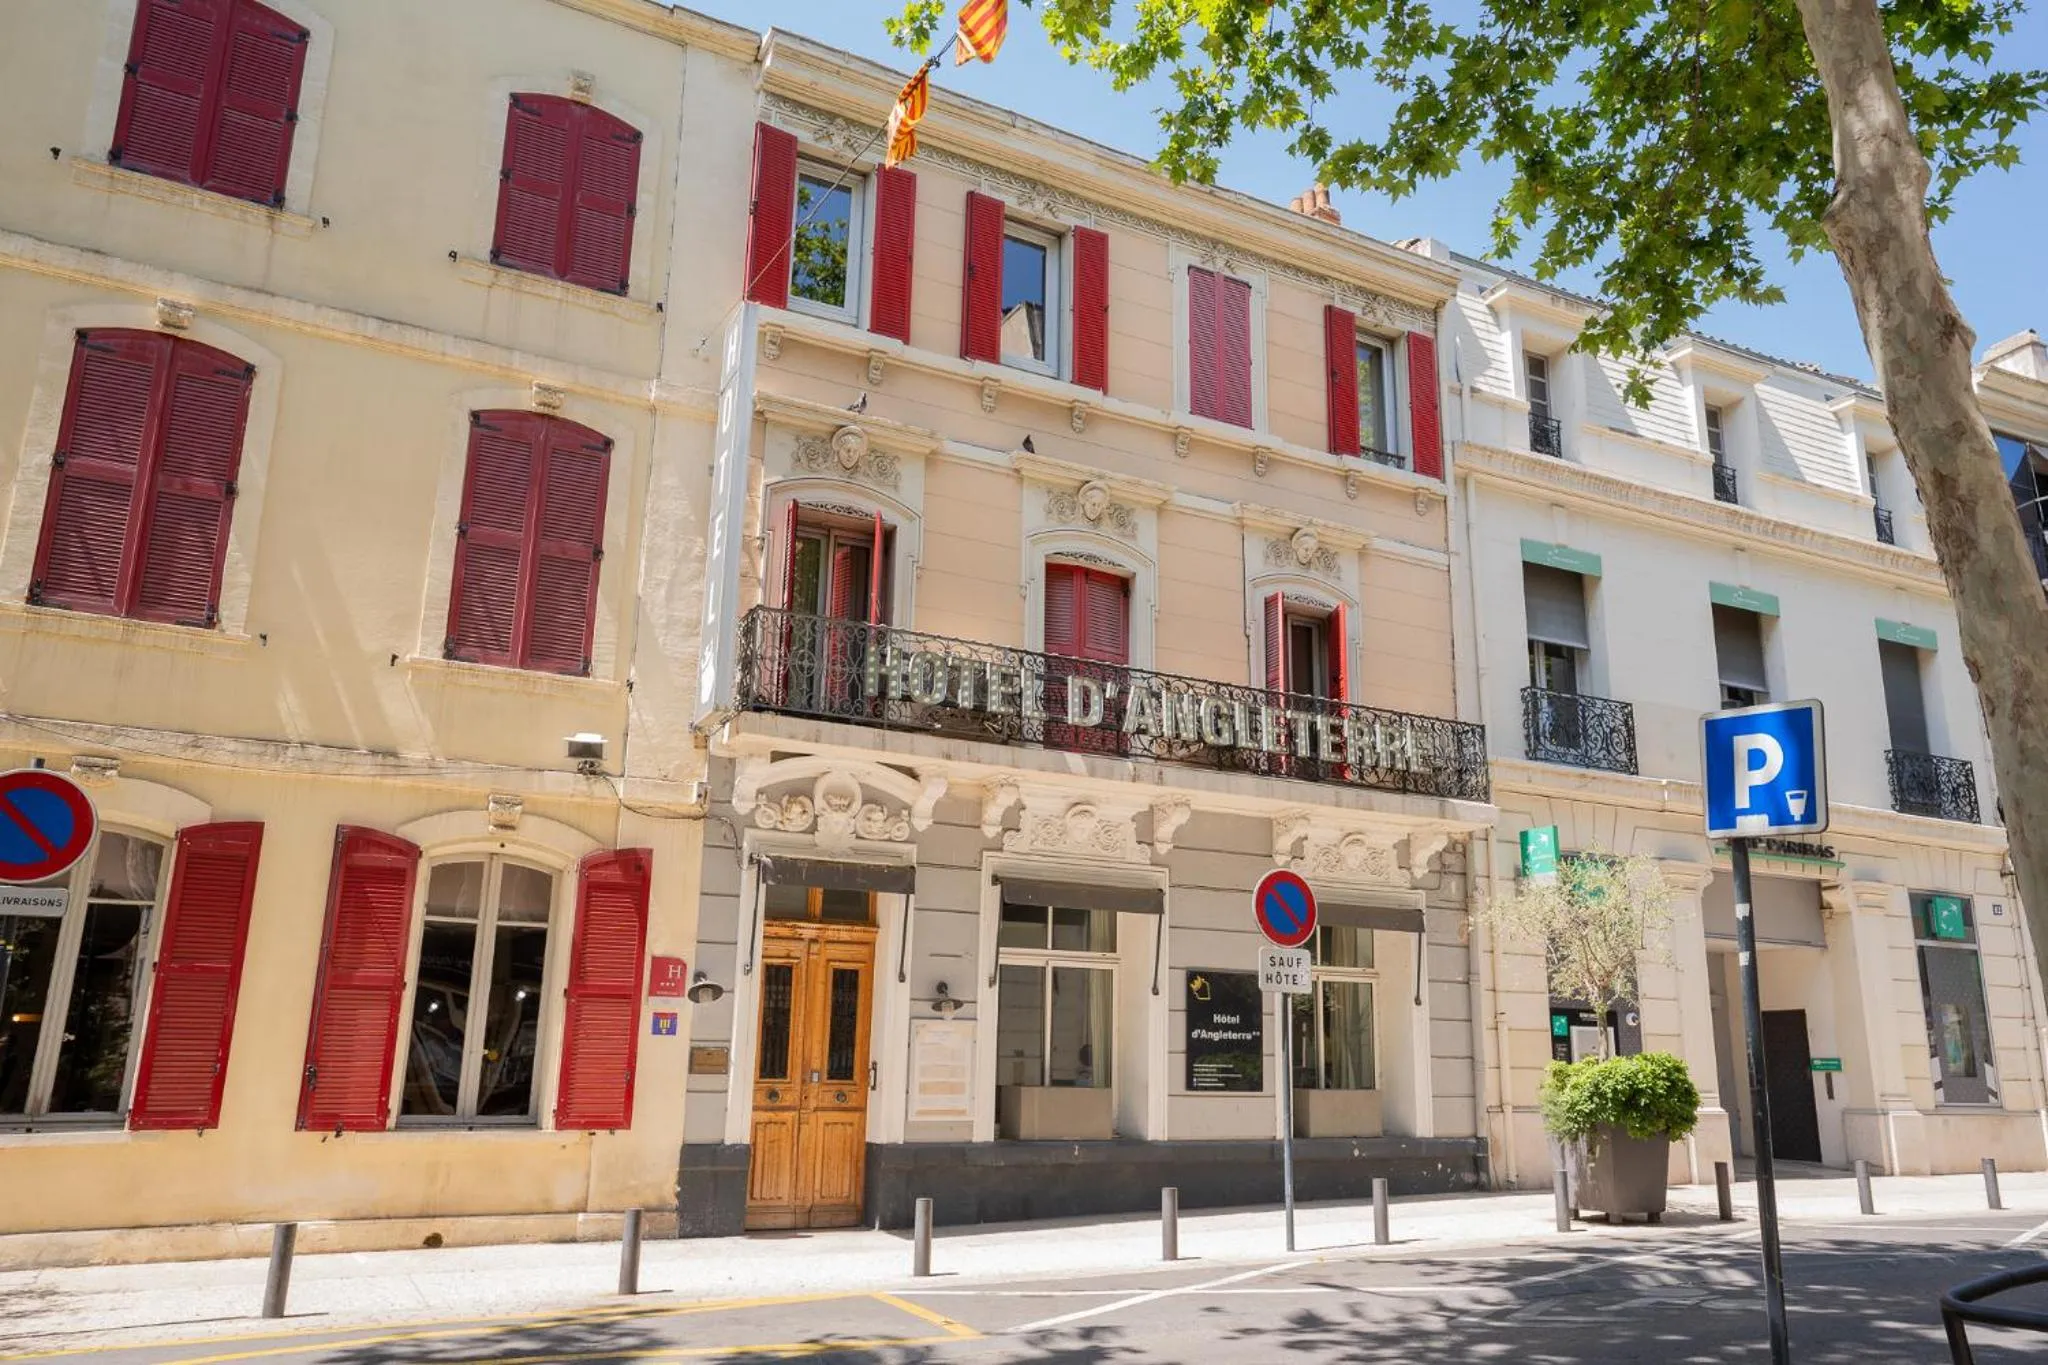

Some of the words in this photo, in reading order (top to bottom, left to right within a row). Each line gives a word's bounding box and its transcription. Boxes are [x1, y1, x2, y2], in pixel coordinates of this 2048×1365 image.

[707, 322, 739, 626] HOTEL
[864, 645, 1048, 721] HOTEL
[1733, 733, 1784, 809] P
[0, 896, 63, 907] IVRAISONS
[1269, 956, 1303, 968] SAUF
[1212, 1013, 1241, 1025] Hôtel
